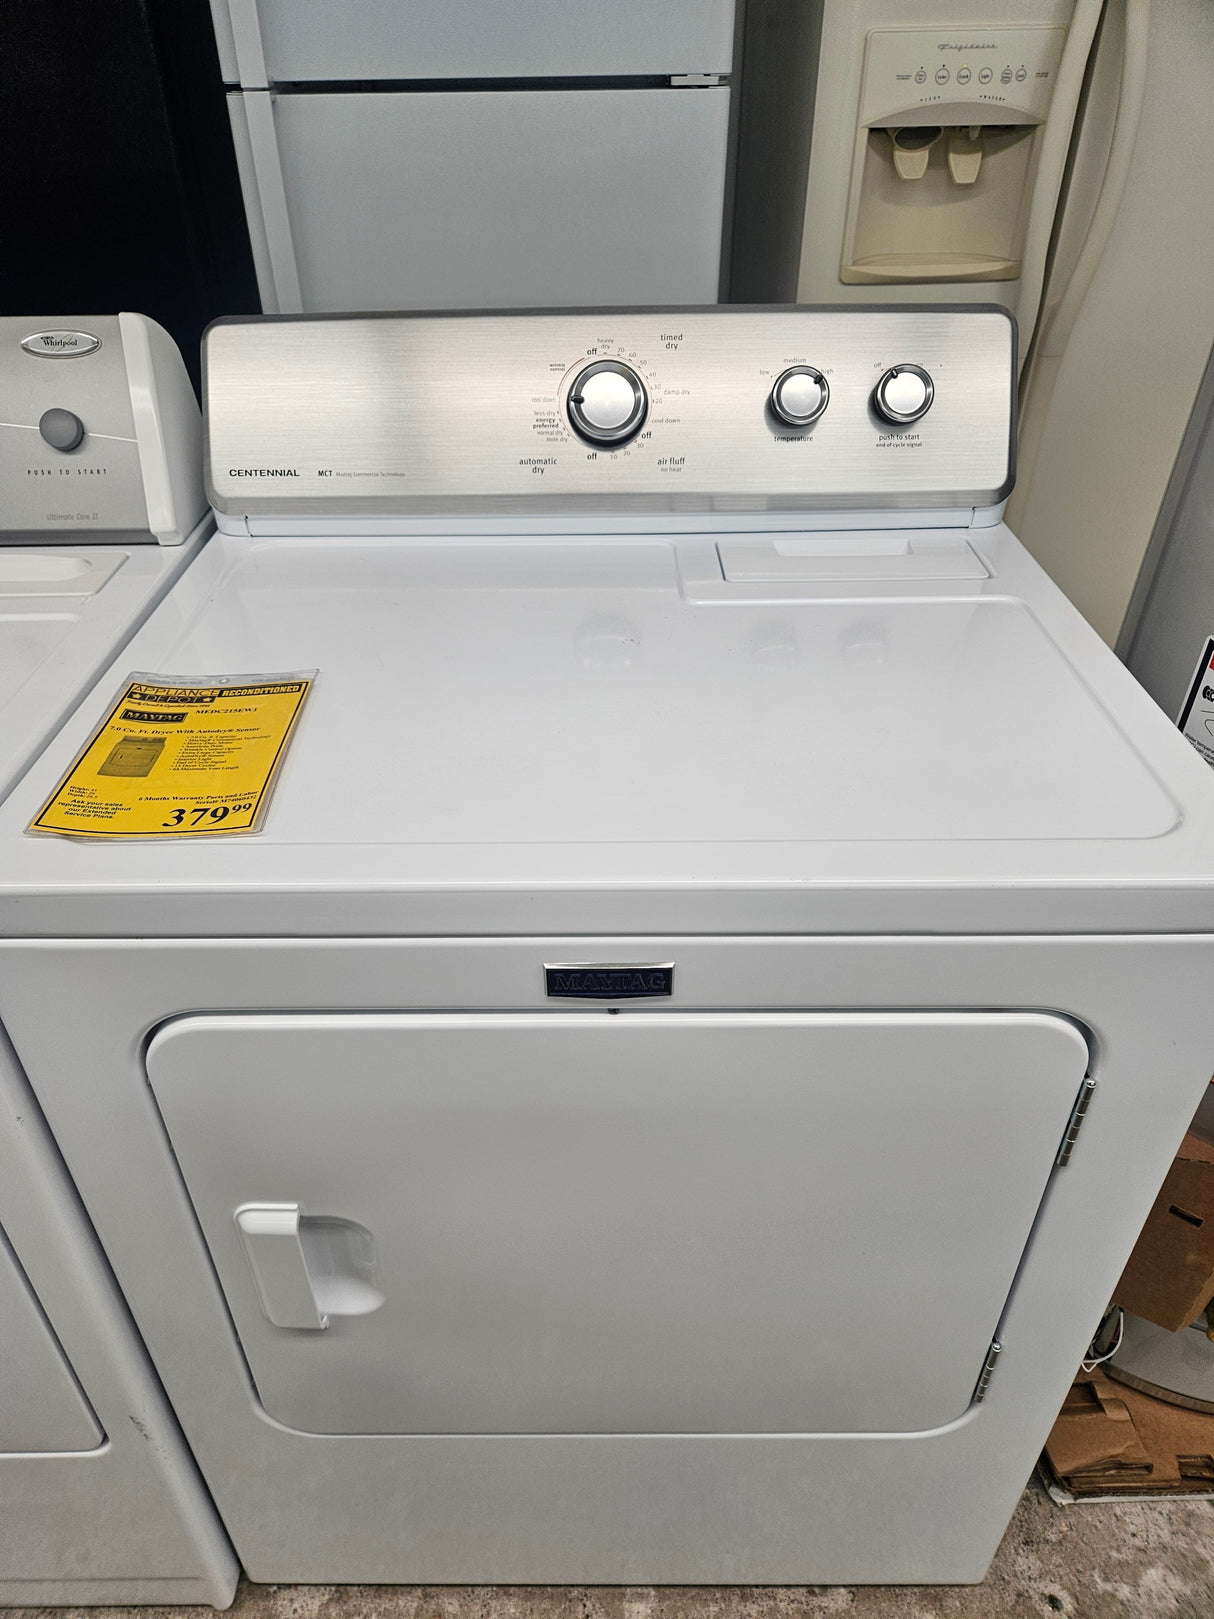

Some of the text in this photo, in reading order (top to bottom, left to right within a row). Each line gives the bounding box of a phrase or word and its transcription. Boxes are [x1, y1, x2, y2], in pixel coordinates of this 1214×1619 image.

[43, 339, 78, 347] Whirlpool
[665, 342, 679, 350] dry
[878, 434, 895, 442] push
[519, 458, 558, 466] automatic
[657, 457, 686, 465] air fluff
[229, 469, 300, 477] CENTENNIAL
[532, 466, 545, 475] dry
[47, 512, 75, 520] Ultimate
[76, 512, 91, 520] Care
[132, 684, 220, 697] APPLIANCE
[221, 684, 301, 697] RECONDITIONED
[145, 694, 198, 703] DEPOT
[195, 707, 258, 715] MEDC215EW1
[126, 711, 183, 721] MAYTAG
[58, 801, 109, 811] representative
[553, 973, 666, 991] MAYTAG
